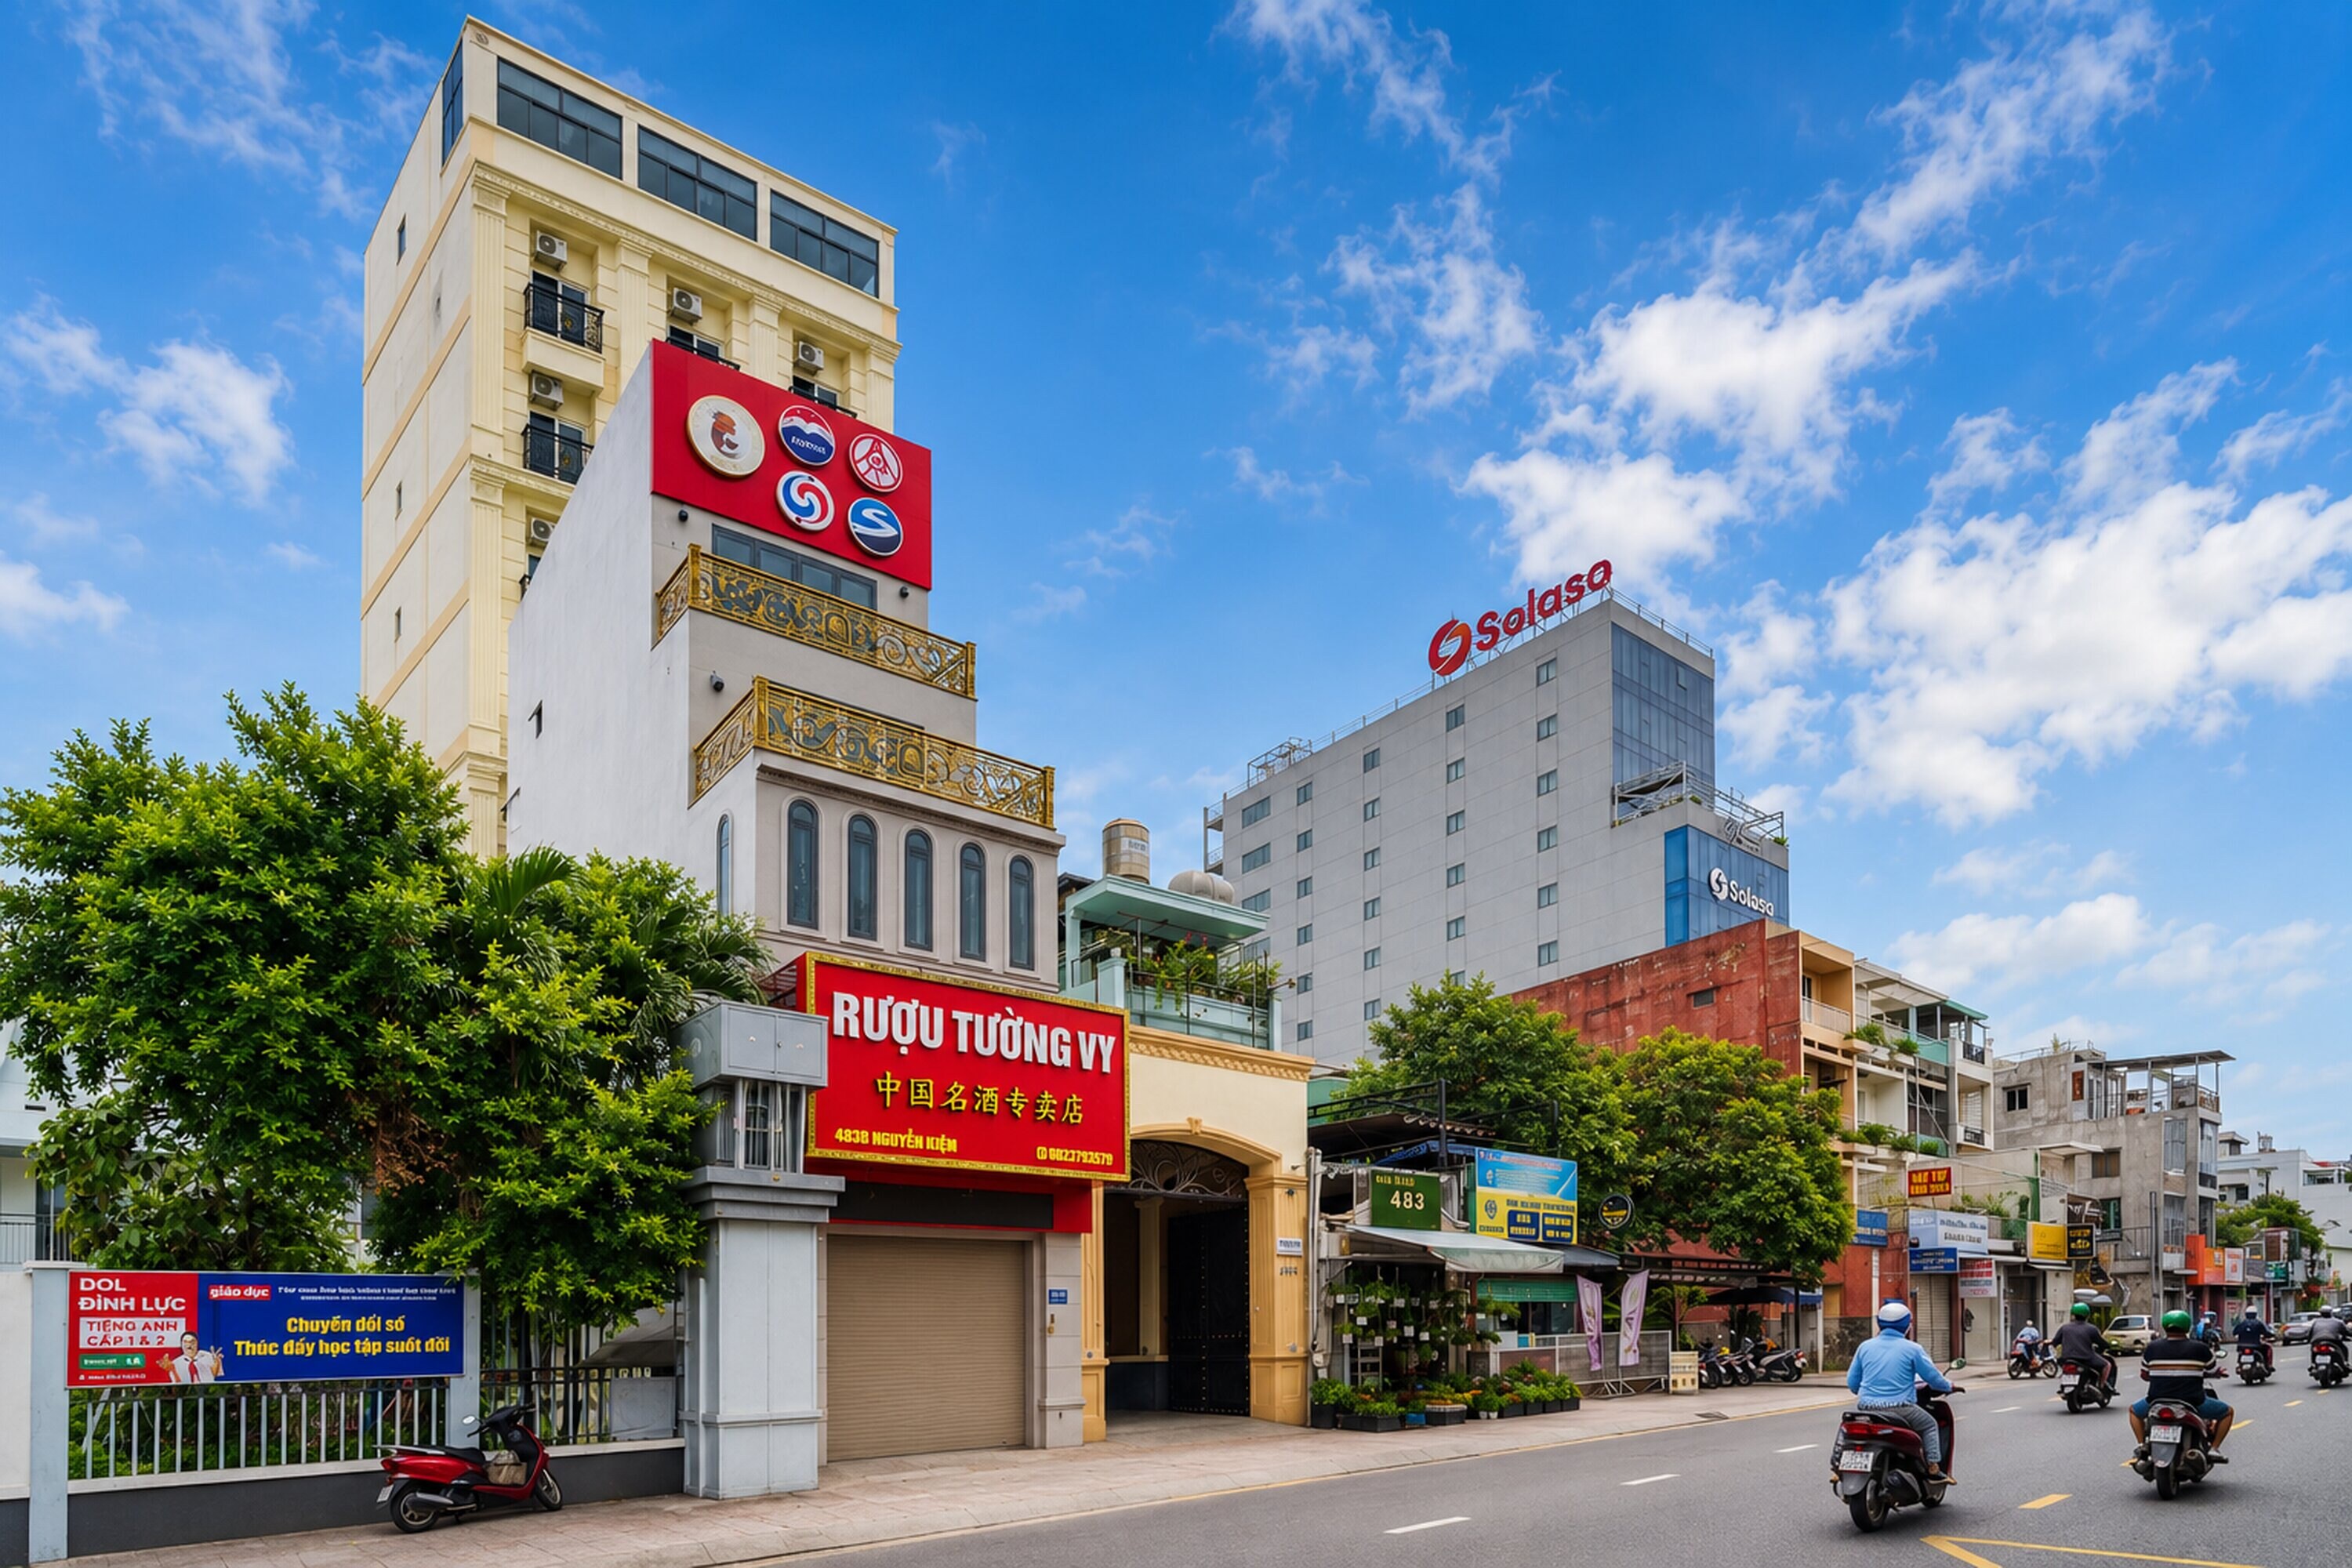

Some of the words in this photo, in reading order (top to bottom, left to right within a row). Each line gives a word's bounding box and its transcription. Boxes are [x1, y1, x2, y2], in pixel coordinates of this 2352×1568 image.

[1475, 559, 1613, 652] Solaso
[833, 991, 944, 1055] RƯỢU
[952, 1007, 1071, 1068] TƯỜNG
[1077, 1031, 1116, 1074] VY
[876, 1070, 1083, 1124] 中国名酒专卖店
[1390, 1190, 1425, 1210] 483
[79, 1278, 127, 1292] DOL
[78, 1294, 135, 1311] ĐÌNH
[141, 1296, 186, 1316] LỰC
[142, 1321, 177, 1332] ANH
[129, 1335, 134, 1346] 1
[156, 1335, 165, 1346] 2
[234, 1338, 279, 1356] Thúc
[318, 1338, 350, 1358] học
